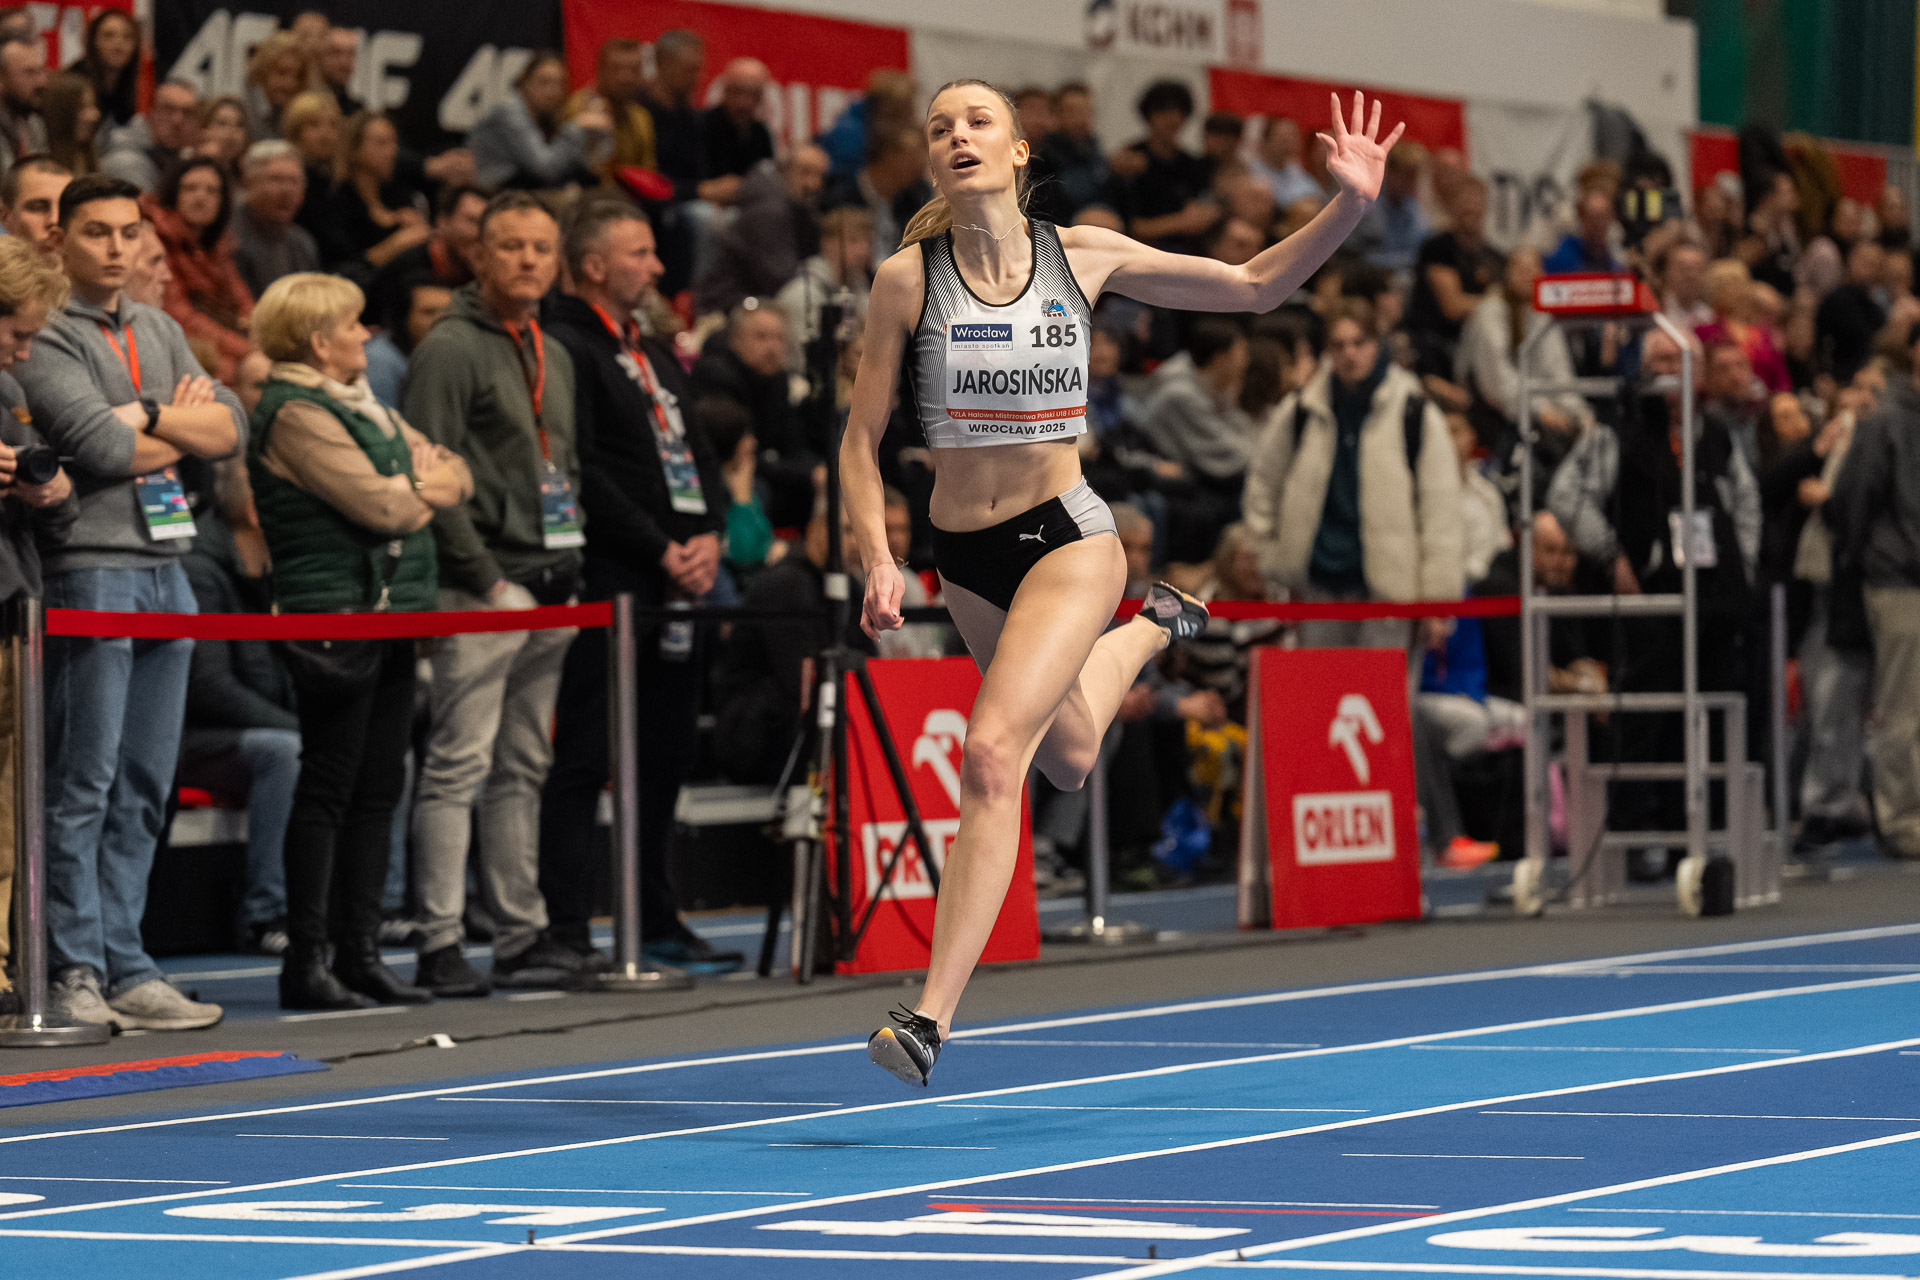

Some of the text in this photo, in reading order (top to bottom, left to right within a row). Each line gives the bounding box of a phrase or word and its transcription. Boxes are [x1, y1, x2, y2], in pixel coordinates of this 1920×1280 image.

[954, 325, 1010, 338] Wrocław
[1029, 323, 1078, 348] 185
[981, 341, 1011, 350] spotkań
[952, 363, 1083, 396] JAROSIŃSKA
[967, 411, 994, 419] Halowe
[995, 412, 1037, 420] Mistrzostwa
[1037, 411, 1056, 419] Polski
[968, 422, 1066, 435] WROCŁAW 2025
[1302, 804, 1385, 852] ORLEN
